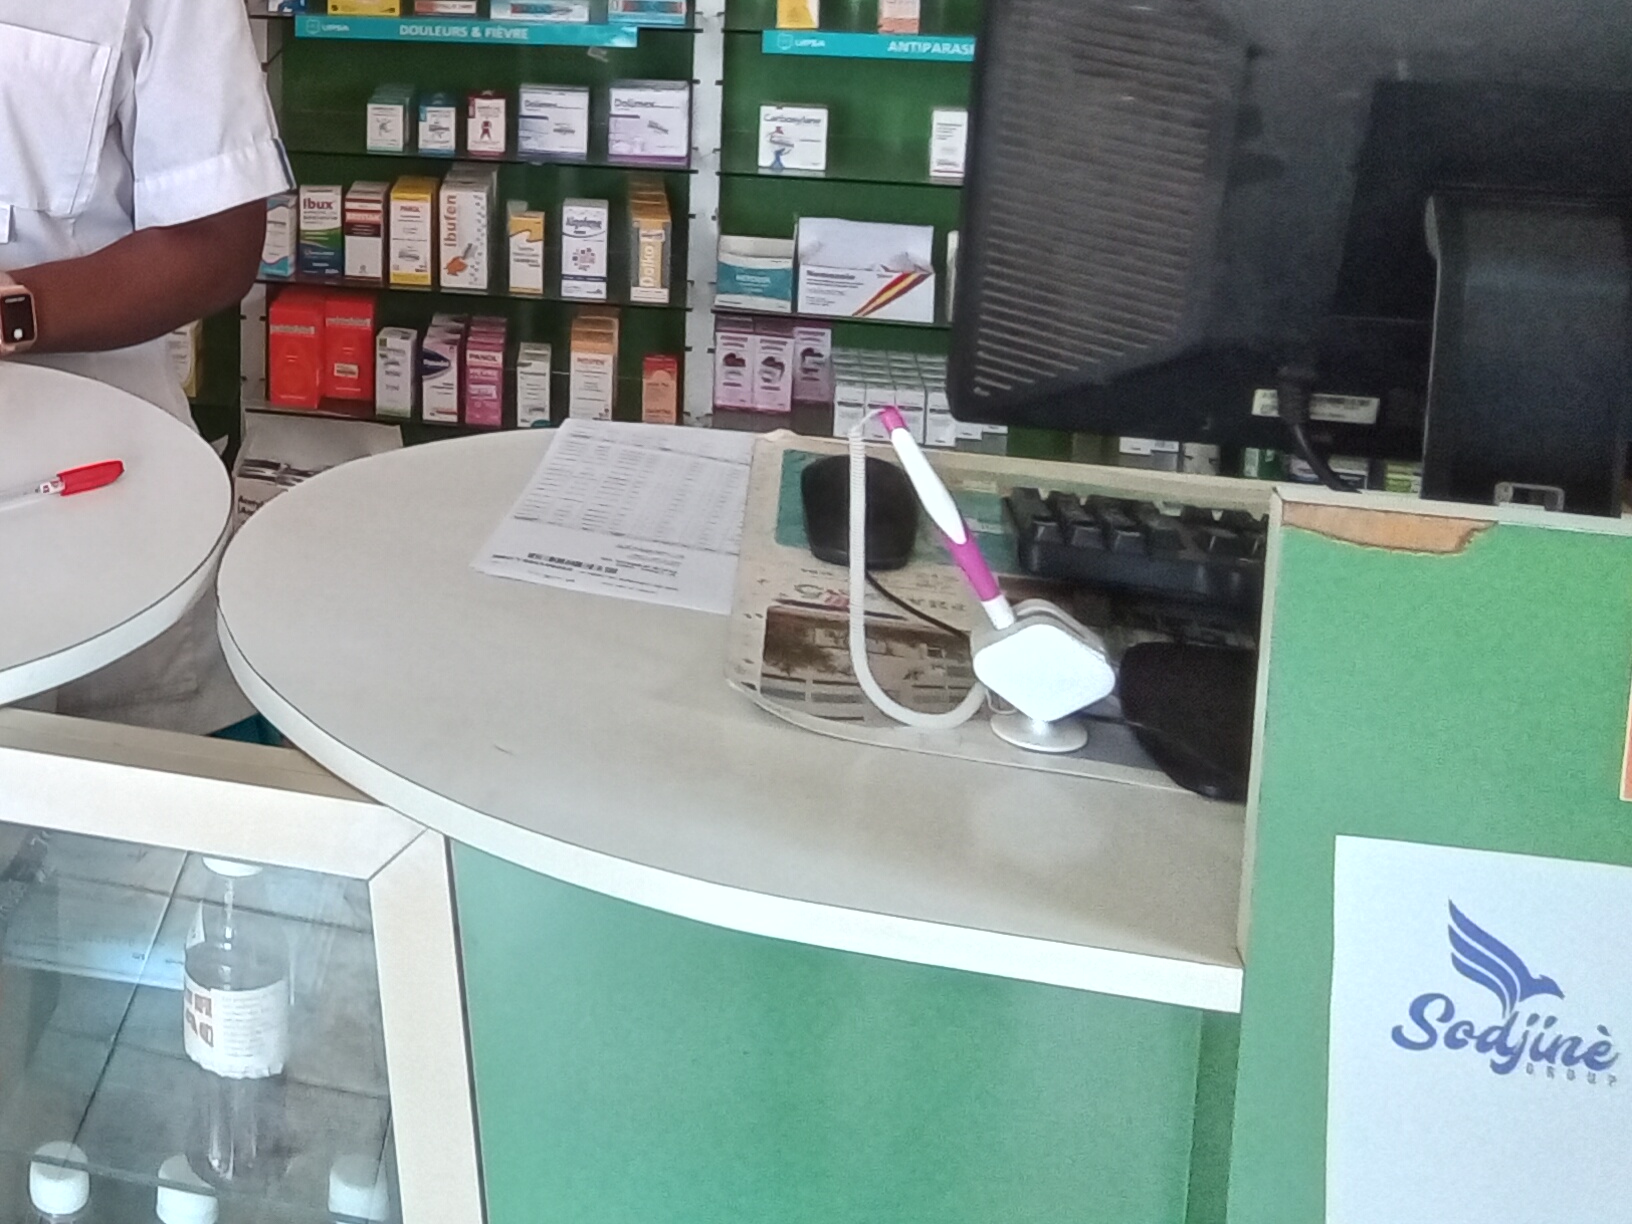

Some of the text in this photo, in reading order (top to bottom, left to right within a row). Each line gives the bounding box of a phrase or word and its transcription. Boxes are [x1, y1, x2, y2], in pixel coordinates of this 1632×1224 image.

[399, 24, 467, 38] DOULEURS
[471, 25, 481, 38] &
[887, 40, 974, 56] ANTIPARASI
[302, 197, 334, 210] Ibux
[443, 194, 457, 247] Ibufen
[641, 244, 655, 286] Dolko
